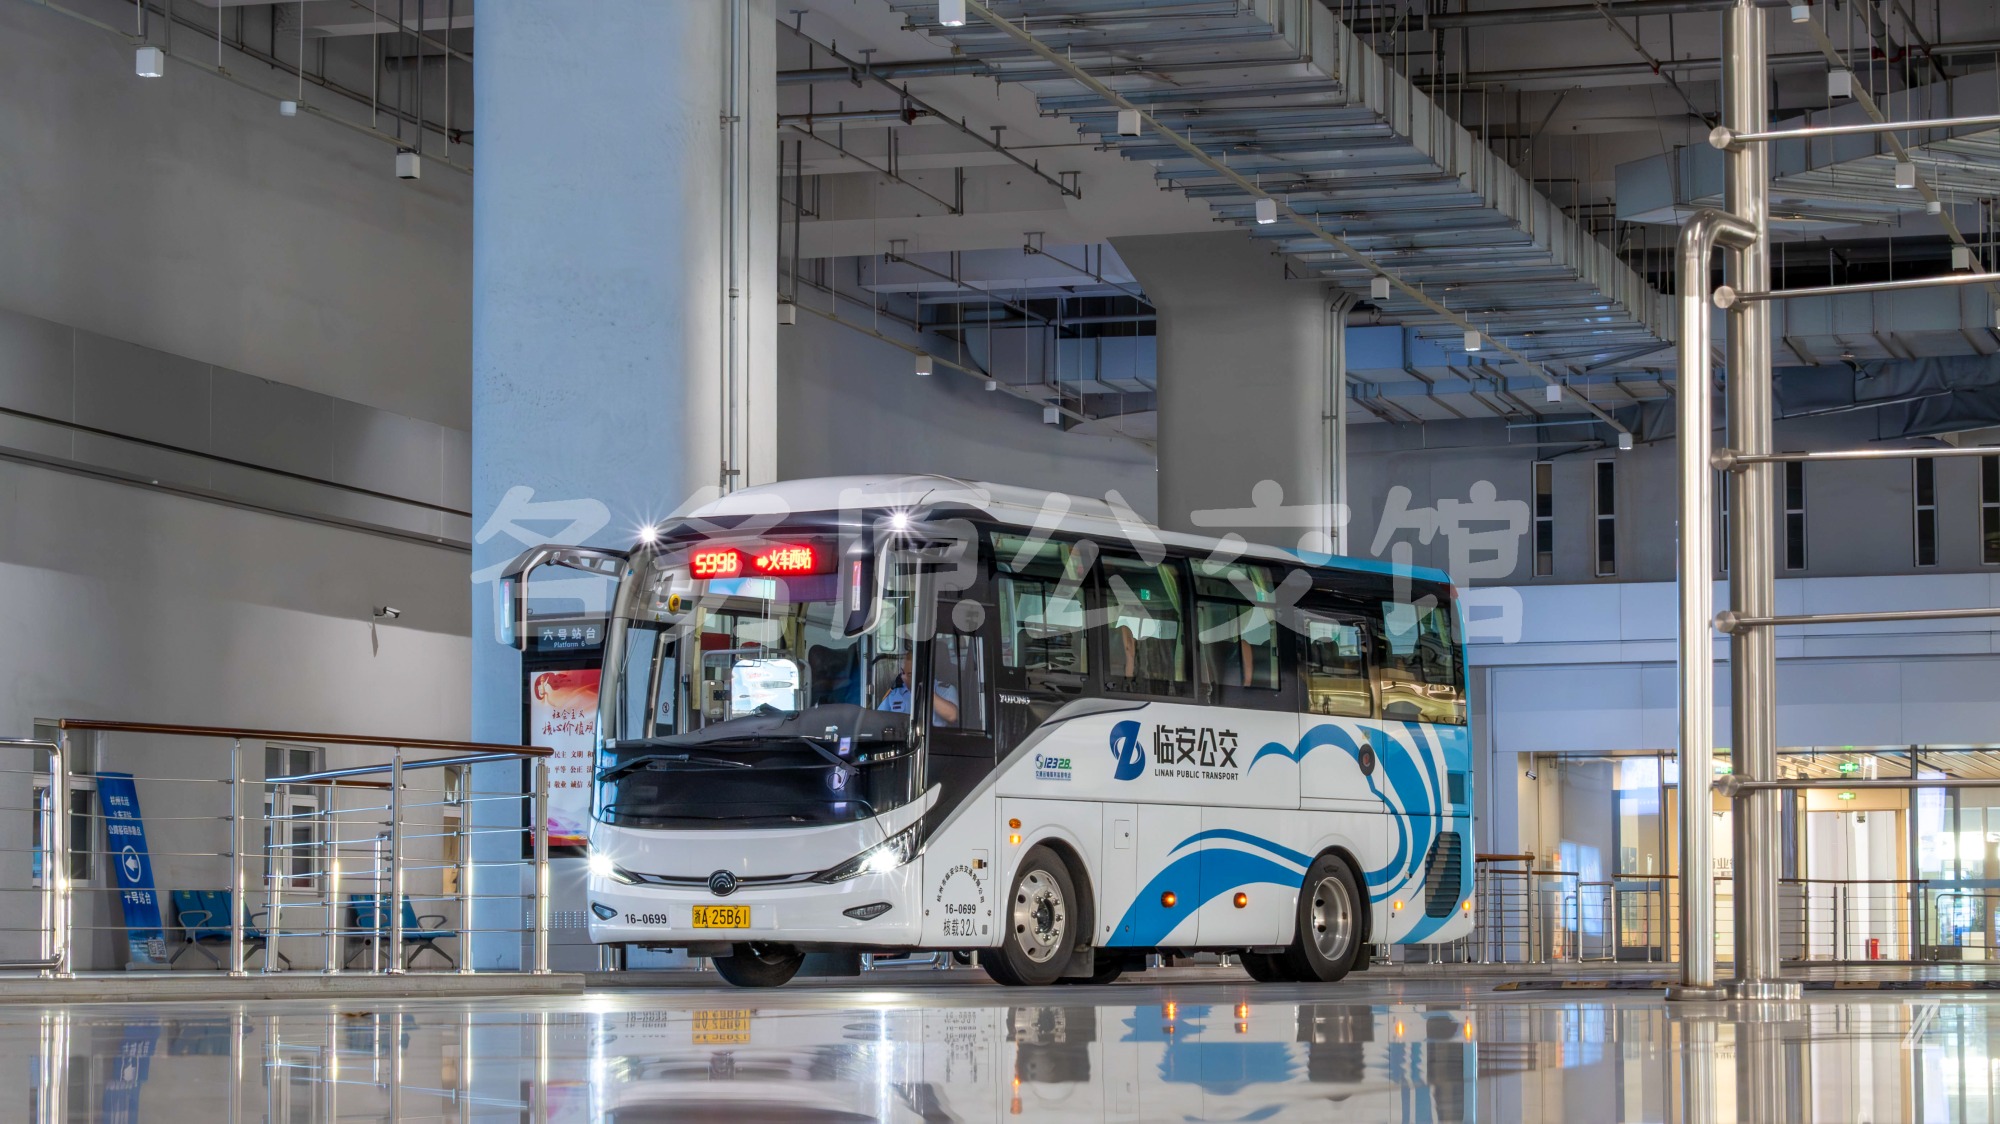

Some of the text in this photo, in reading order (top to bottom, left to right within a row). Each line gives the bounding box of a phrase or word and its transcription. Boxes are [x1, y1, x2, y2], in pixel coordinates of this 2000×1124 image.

[768, 548, 812, 571] 火车西站
[543, 627, 596, 640] 六号站台
[552, 708, 585, 720] 社会主义
[541, 721, 595, 736] 核心价值观
[1153, 724, 1238, 768] 临安公交
[554, 750, 567, 759] 民主
[570, 750, 584, 758] 文明
[554, 765, 567, 773] 平等
[570, 765, 583, 773] 公正
[1044, 757, 1071, 769] 12328
[1154, 769, 1239, 781] LINAN PUBLIC TRANSPORT
[945, 903, 977, 914] 16-0699
[624, 913, 667, 924] 16-0699
[943, 918, 977, 937] 核载32人
